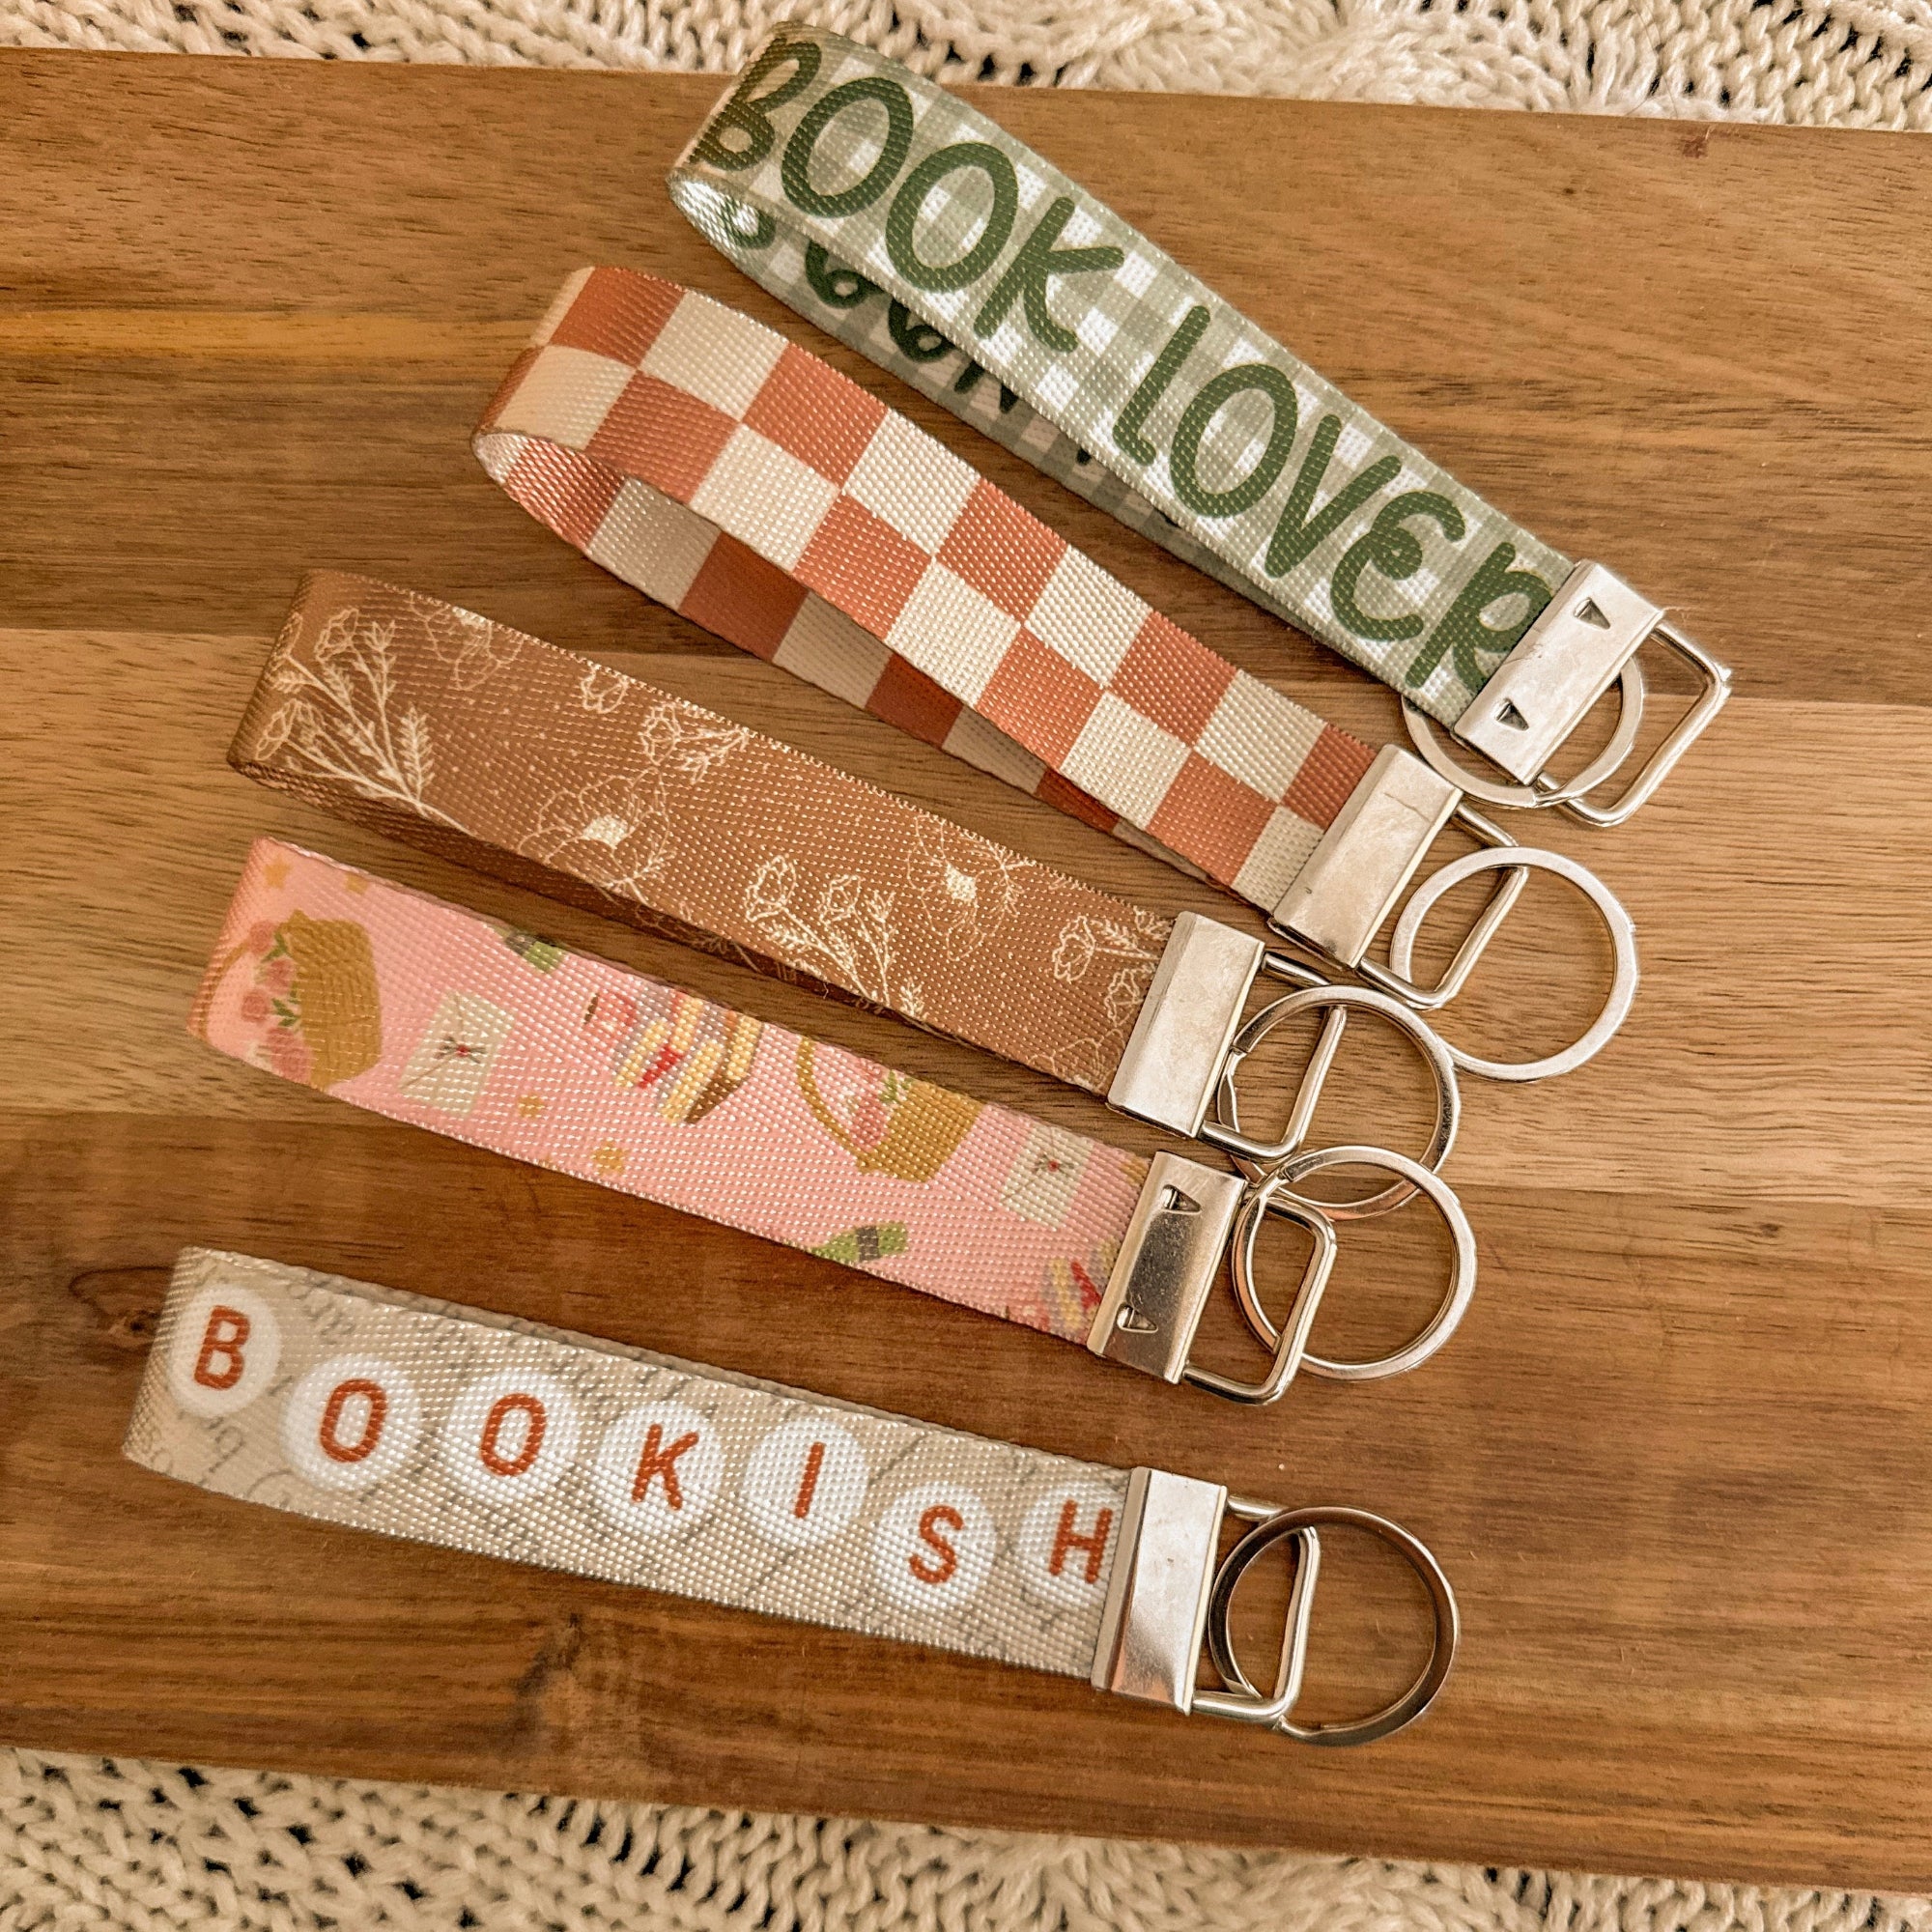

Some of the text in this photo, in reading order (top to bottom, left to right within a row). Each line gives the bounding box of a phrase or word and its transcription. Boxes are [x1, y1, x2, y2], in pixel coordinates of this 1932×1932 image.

[688, 38, 1126, 354] BOOK
[1112, 305, 1552, 696] LOVER
[193, 1304, 1114, 1584] BOOKISH
